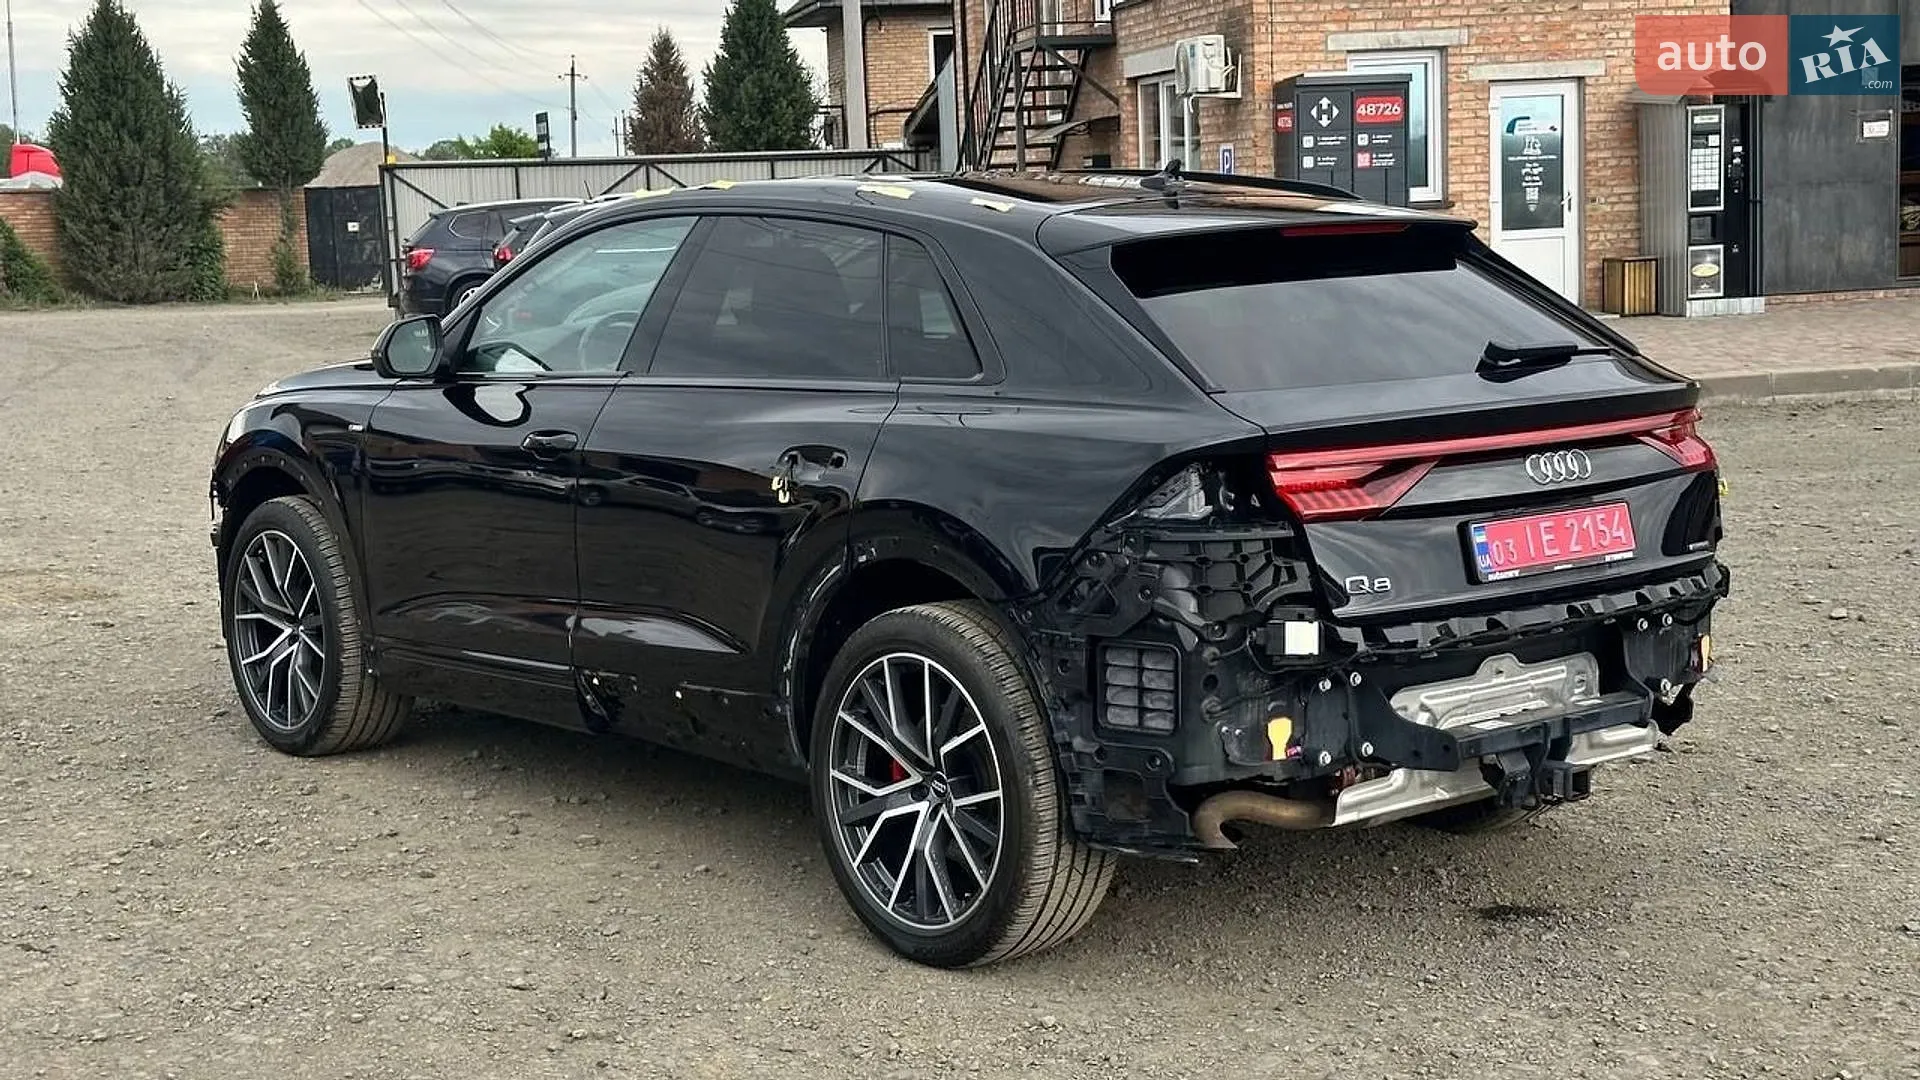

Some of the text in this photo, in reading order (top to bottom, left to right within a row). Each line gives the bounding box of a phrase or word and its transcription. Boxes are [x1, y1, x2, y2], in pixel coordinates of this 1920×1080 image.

[1356, 102, 1401, 116] 48726
[1493, 510, 1628, 565] 03 IE 2154
[1479, 553, 1492, 569] UA
[1345, 575, 1391, 594] Q8
